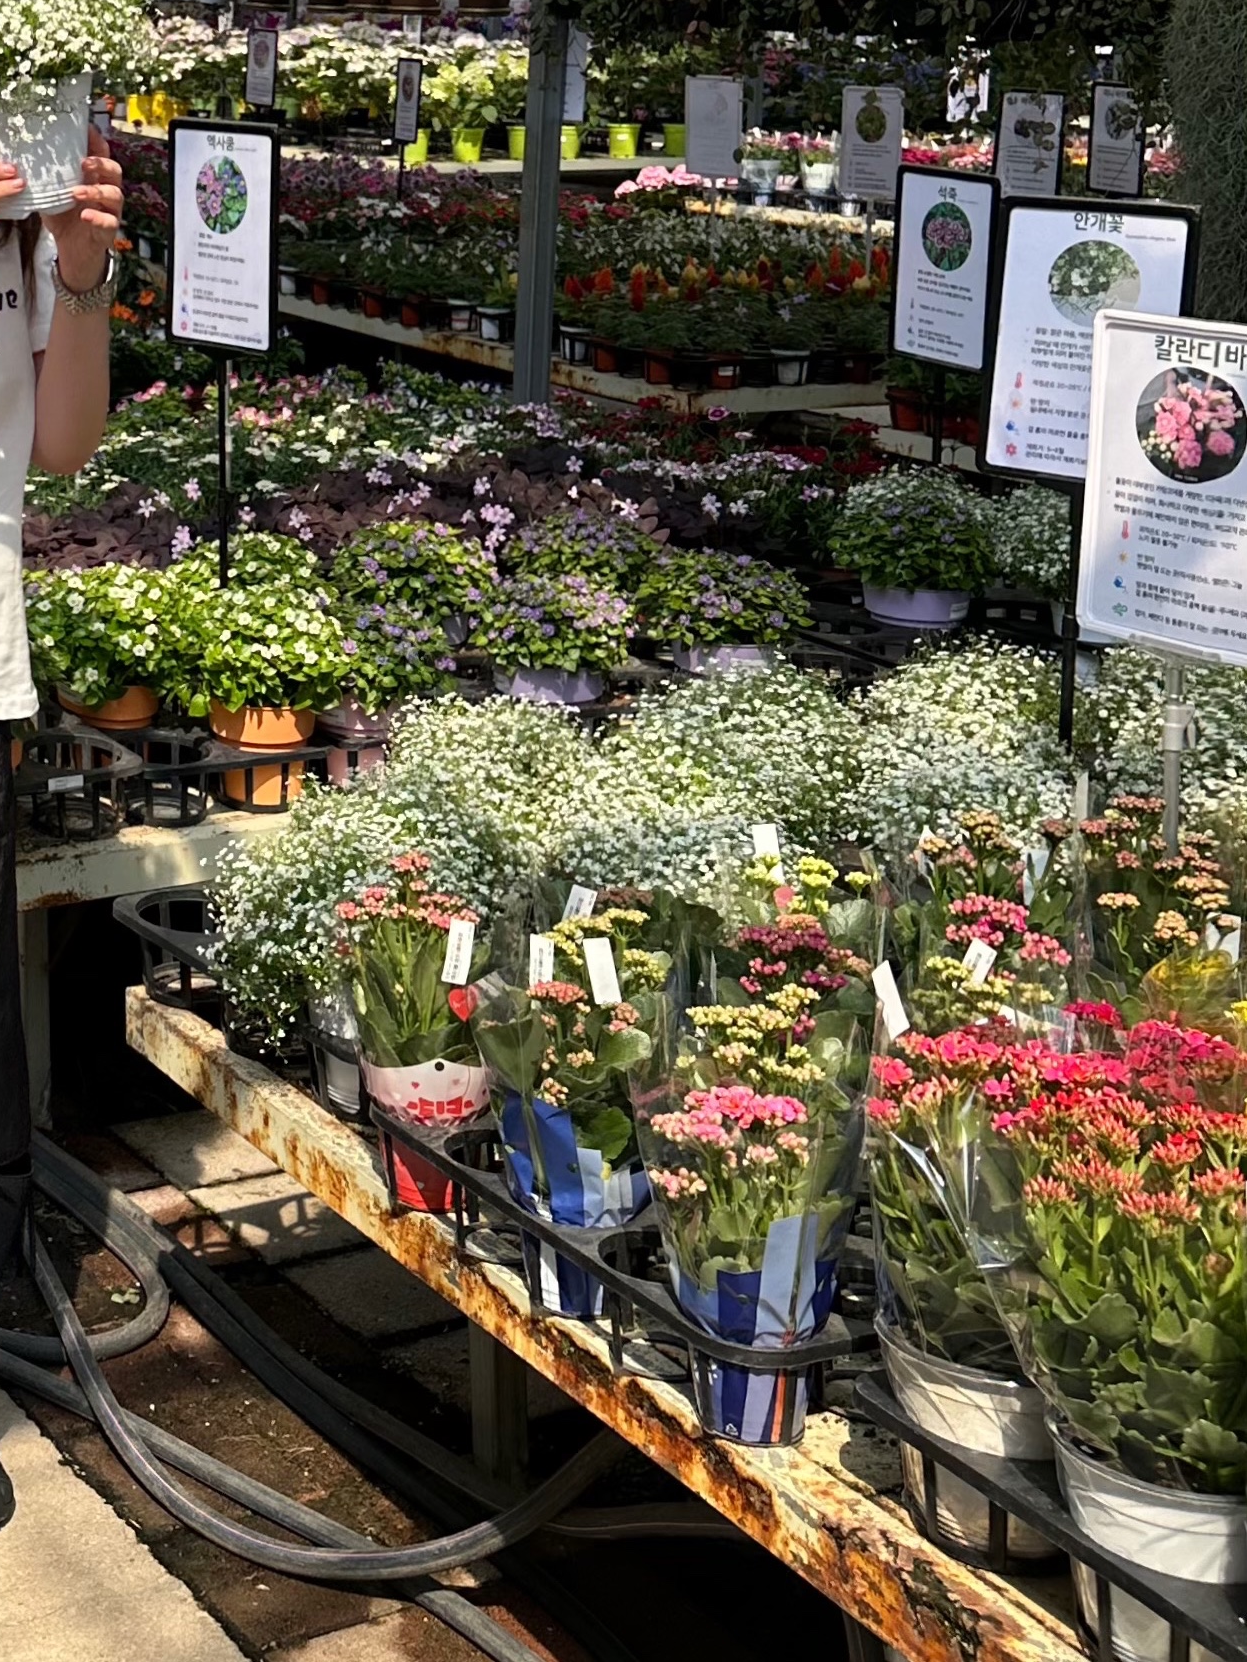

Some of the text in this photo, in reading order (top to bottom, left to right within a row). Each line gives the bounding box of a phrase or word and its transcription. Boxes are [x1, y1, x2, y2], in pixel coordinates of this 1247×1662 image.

[938, 185, 958, 202] 석죽
[1073, 211, 1125, 234] 안개꽃
[1155, 335, 1247, 371] 칼란디바
